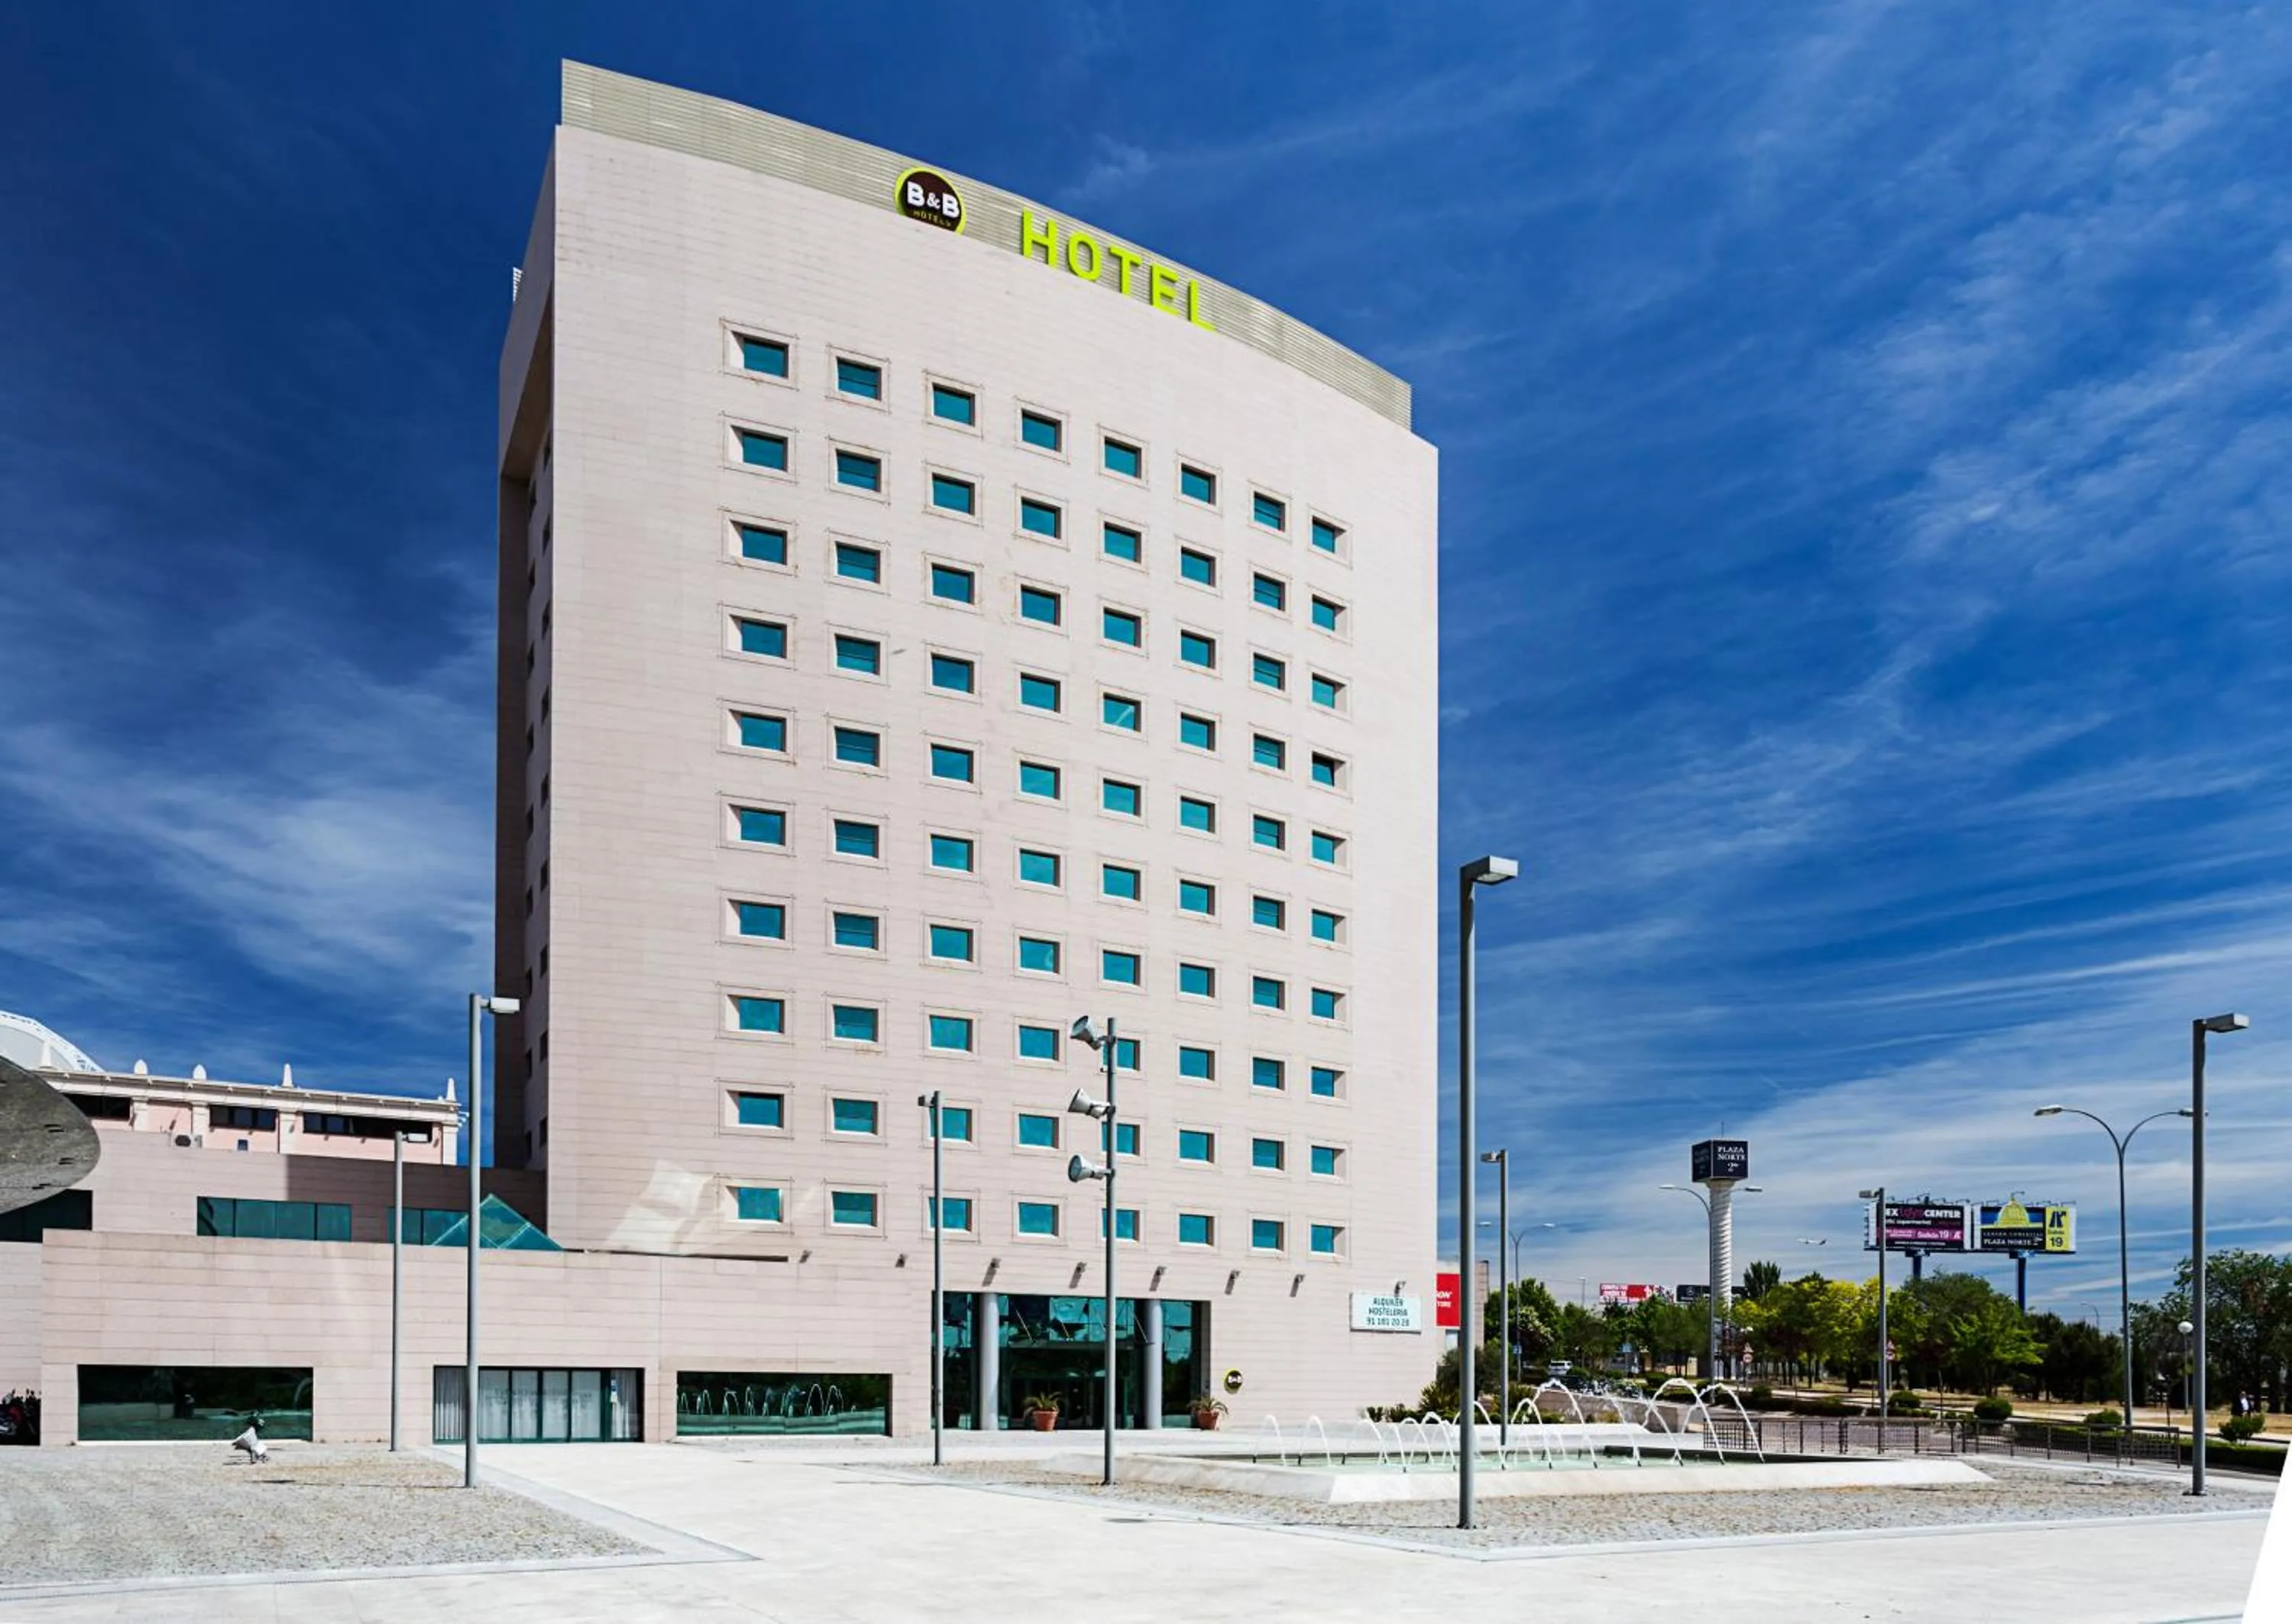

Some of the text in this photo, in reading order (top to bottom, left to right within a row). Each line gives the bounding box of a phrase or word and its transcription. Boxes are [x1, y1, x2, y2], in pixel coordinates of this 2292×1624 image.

[907, 181, 960, 218] B&B
[1021, 206, 1216, 332] HOTEL
[1924, 1209, 1961, 1218] CENTER
[1939, 1230, 1949, 1238] 19
[2050, 1237, 2064, 1247] 19
[1373, 1297, 1403, 1307] ALQUILER
